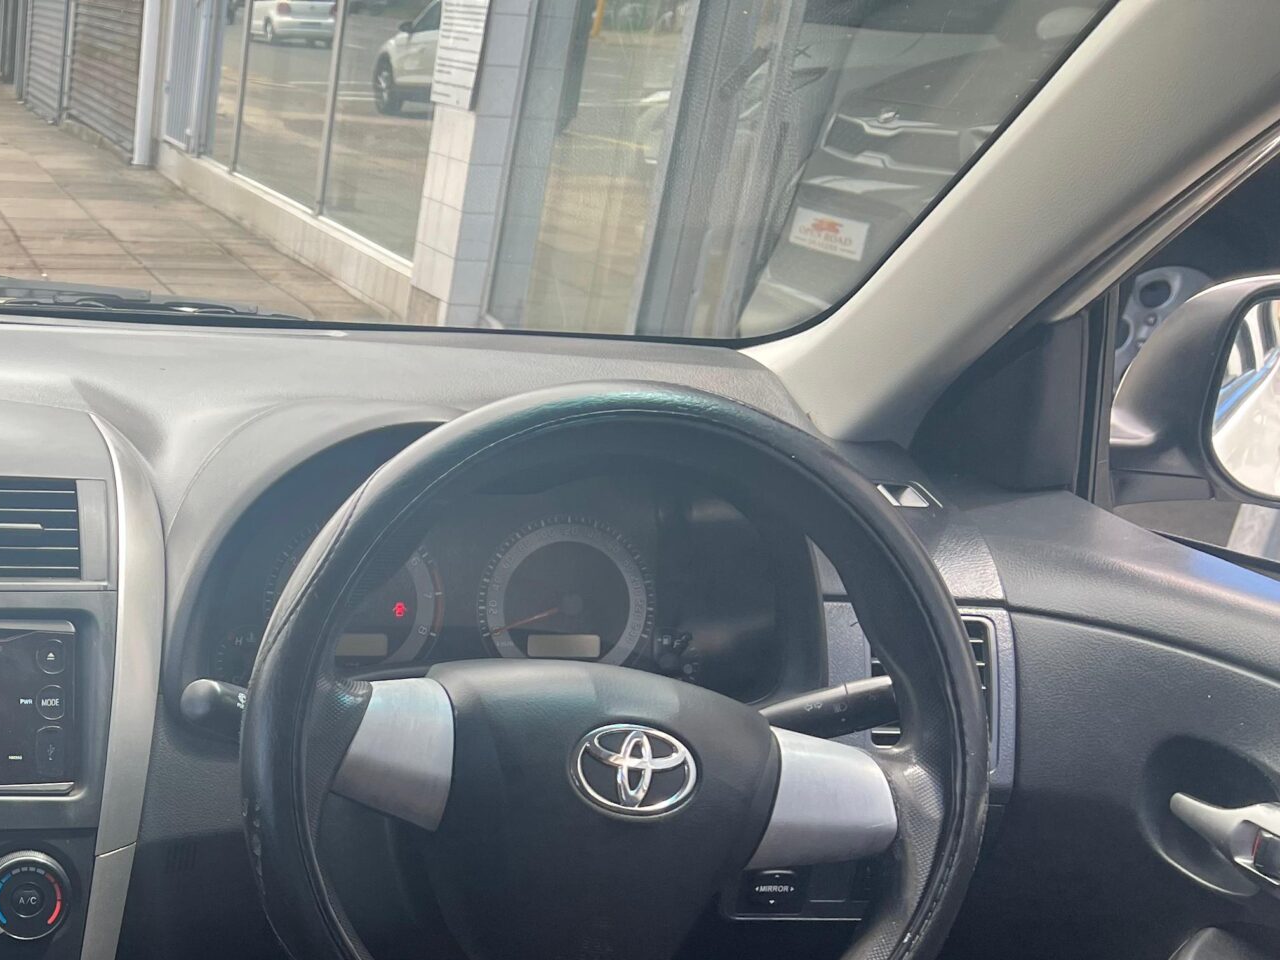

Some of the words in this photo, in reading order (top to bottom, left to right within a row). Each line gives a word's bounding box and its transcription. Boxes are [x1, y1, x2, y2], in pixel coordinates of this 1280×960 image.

[41, 698, 60, 707] MODE
[759, 885, 789, 893] MIRROR
[19, 896, 37, 904] A/C
